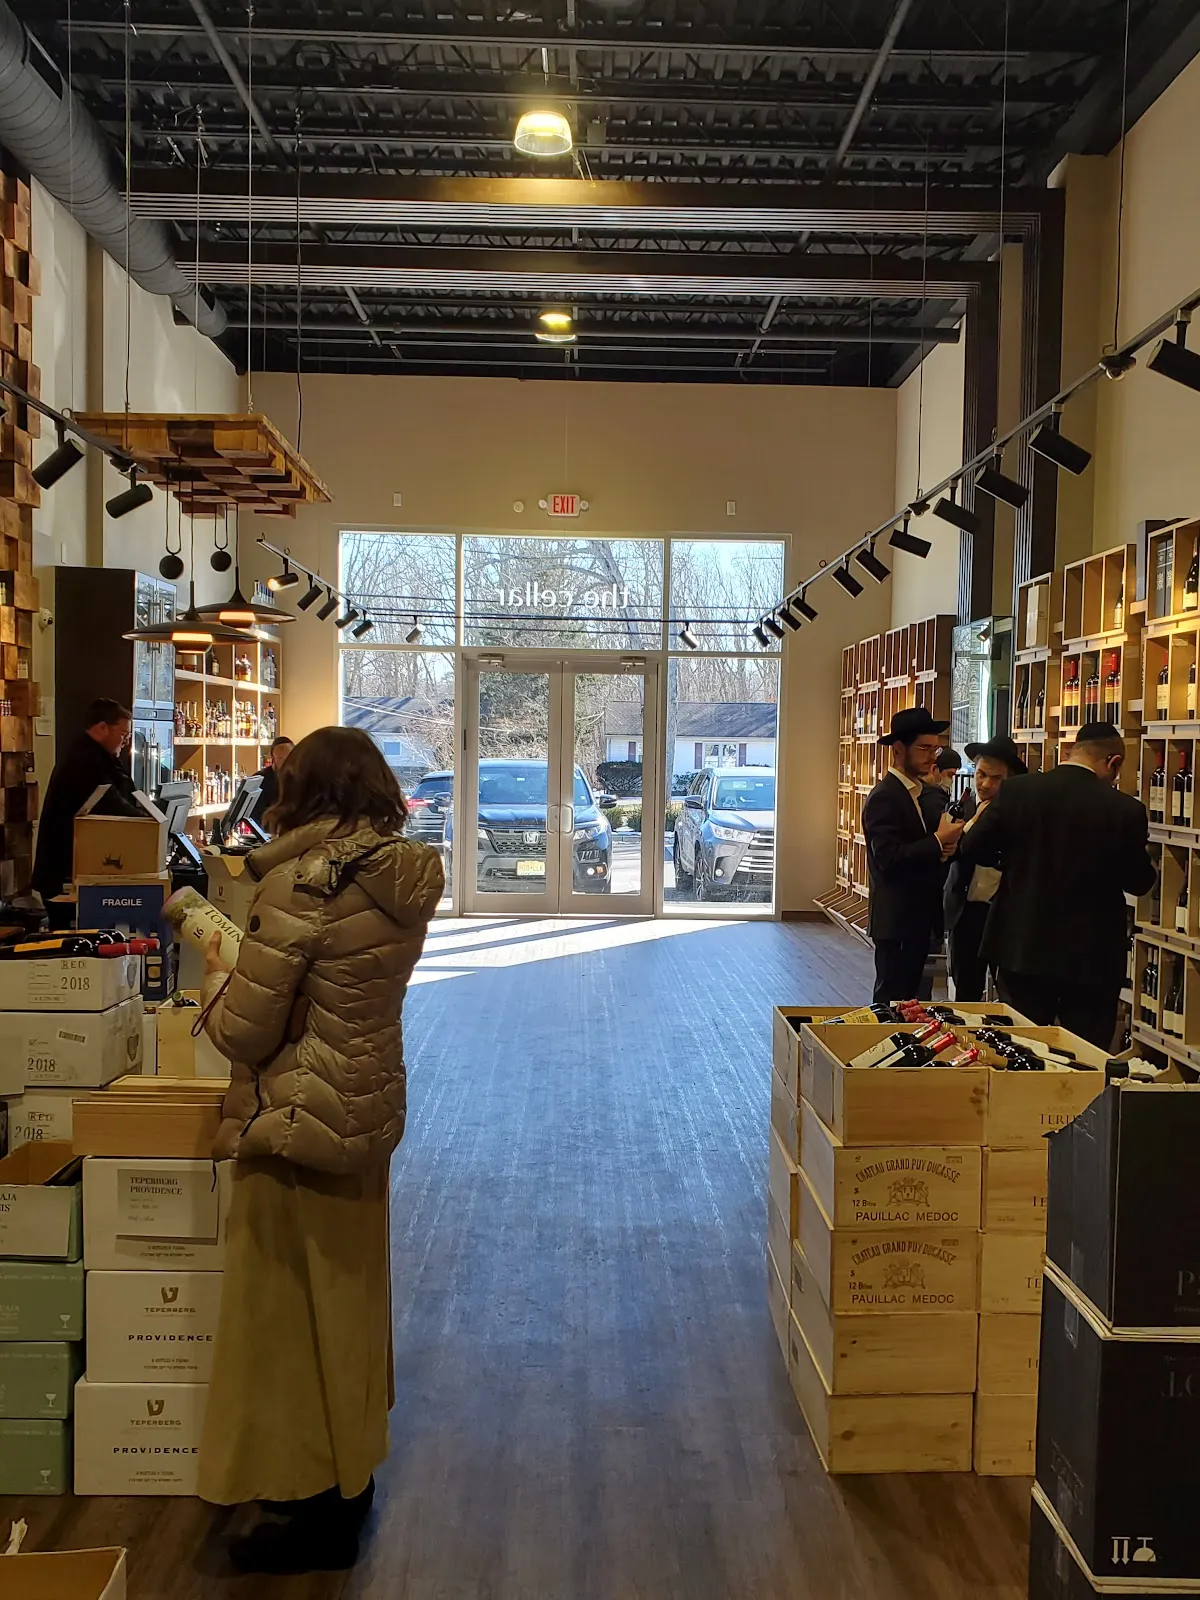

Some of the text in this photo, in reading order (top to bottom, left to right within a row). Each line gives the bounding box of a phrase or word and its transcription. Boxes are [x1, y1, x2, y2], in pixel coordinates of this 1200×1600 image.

[553, 495, 576, 514] EXIT
[102, 898, 143, 907] FRAGILE
[193, 927, 204, 940] 16
[61, 960, 86, 969] RED
[61, 976, 90, 990] 2018
[27, 1057, 56, 1072] 2018
[14, 1125, 43, 1141] 2018
[855, 1158, 961, 1184] CHATEAU GRAND PUY DUCASSE
[130, 1176, 178, 1186] TEPERBERG
[130, 1186, 183, 1196] PROVIDENCE
[852, 1199, 861, 1208] 12
[855, 1211, 960, 1222] PAUILLAC MEDOC
[882, 1241, 907, 1255] GRAND
[907, 1240, 923, 1254] PUY
[922, 1243, 957, 1266] DUCASSE
[848, 1281, 858, 1290] 12
[851, 1294, 955, 1304] PAUILLAC MEDOC
[128, 1334, 213, 1342] PROVIDENCE
[130, 1419, 182, 1427] TEPERBERG
